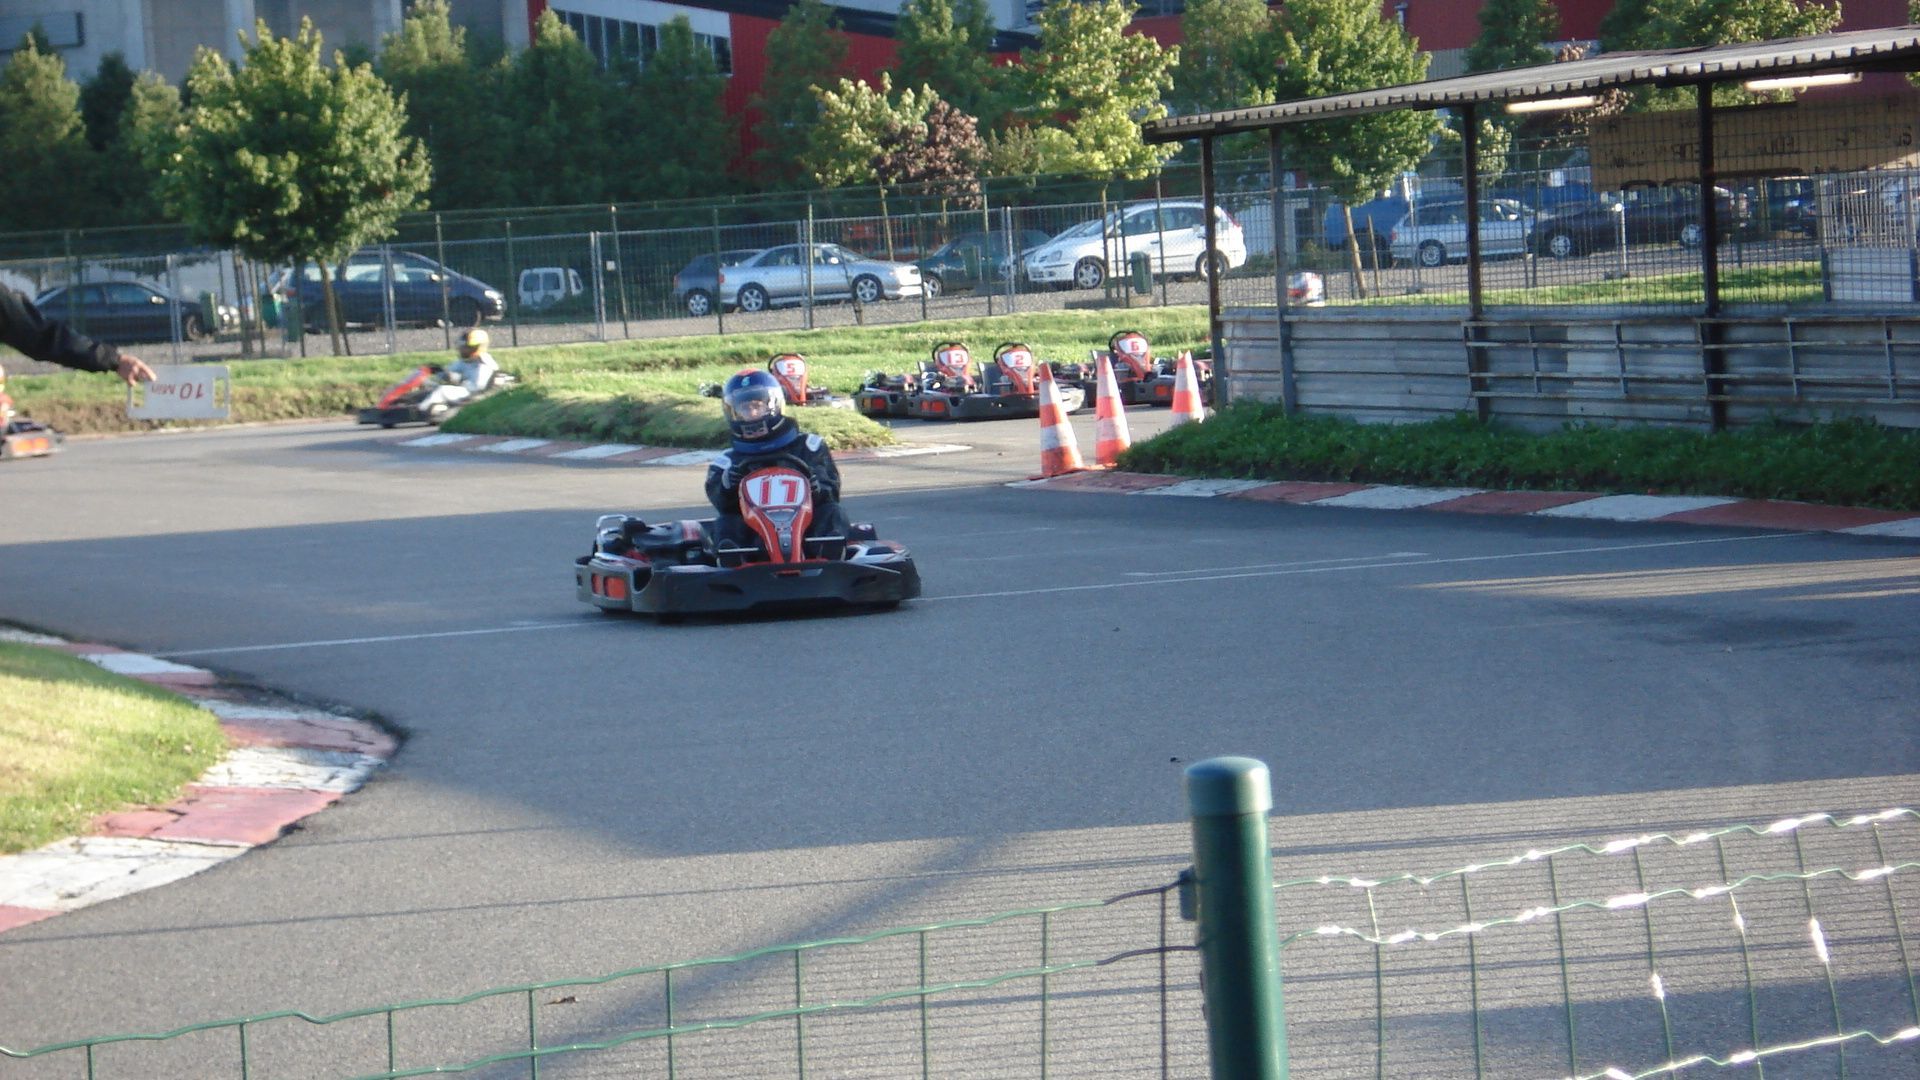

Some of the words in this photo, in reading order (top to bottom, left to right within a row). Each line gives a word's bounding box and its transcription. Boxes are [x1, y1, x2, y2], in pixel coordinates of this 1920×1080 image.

[1130, 341, 1140, 352] 6
[947, 353, 964, 364] 13
[1014, 354, 1026, 366] 2
[786, 363, 796, 376] 5
[179, 382, 203, 400] 10
[760, 479, 799, 506] 17
